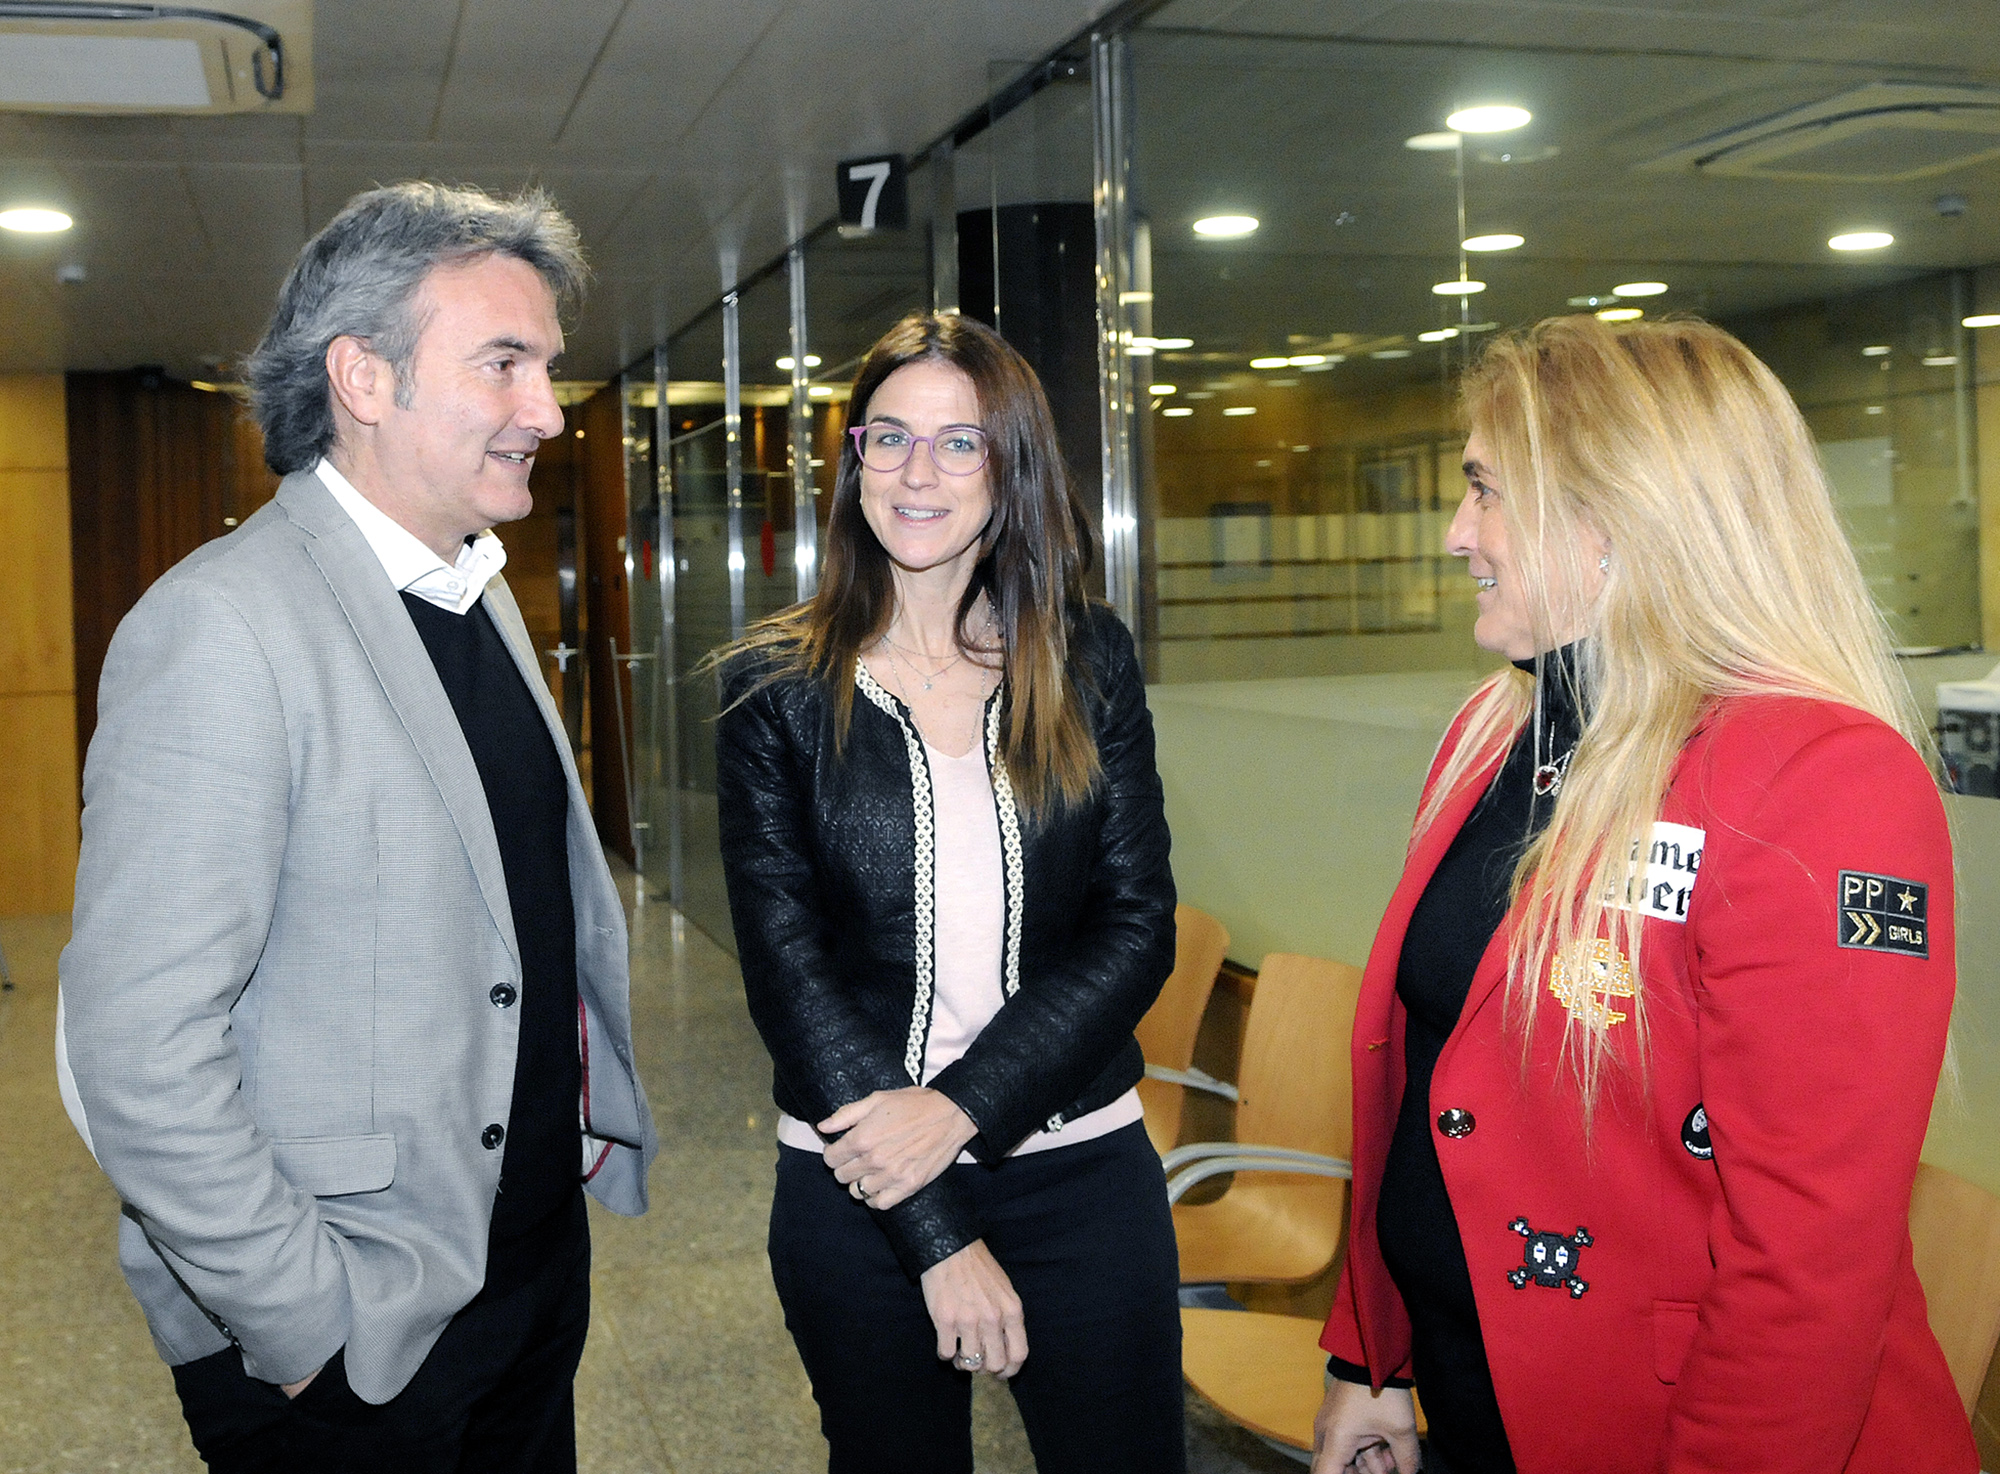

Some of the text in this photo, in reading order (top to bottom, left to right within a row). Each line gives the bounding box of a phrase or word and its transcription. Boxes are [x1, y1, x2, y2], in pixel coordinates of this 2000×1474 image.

[848, 161, 891, 230] 7
[1844, 875, 1884, 909] PP
[1888, 924, 1923, 946] GIRLS
